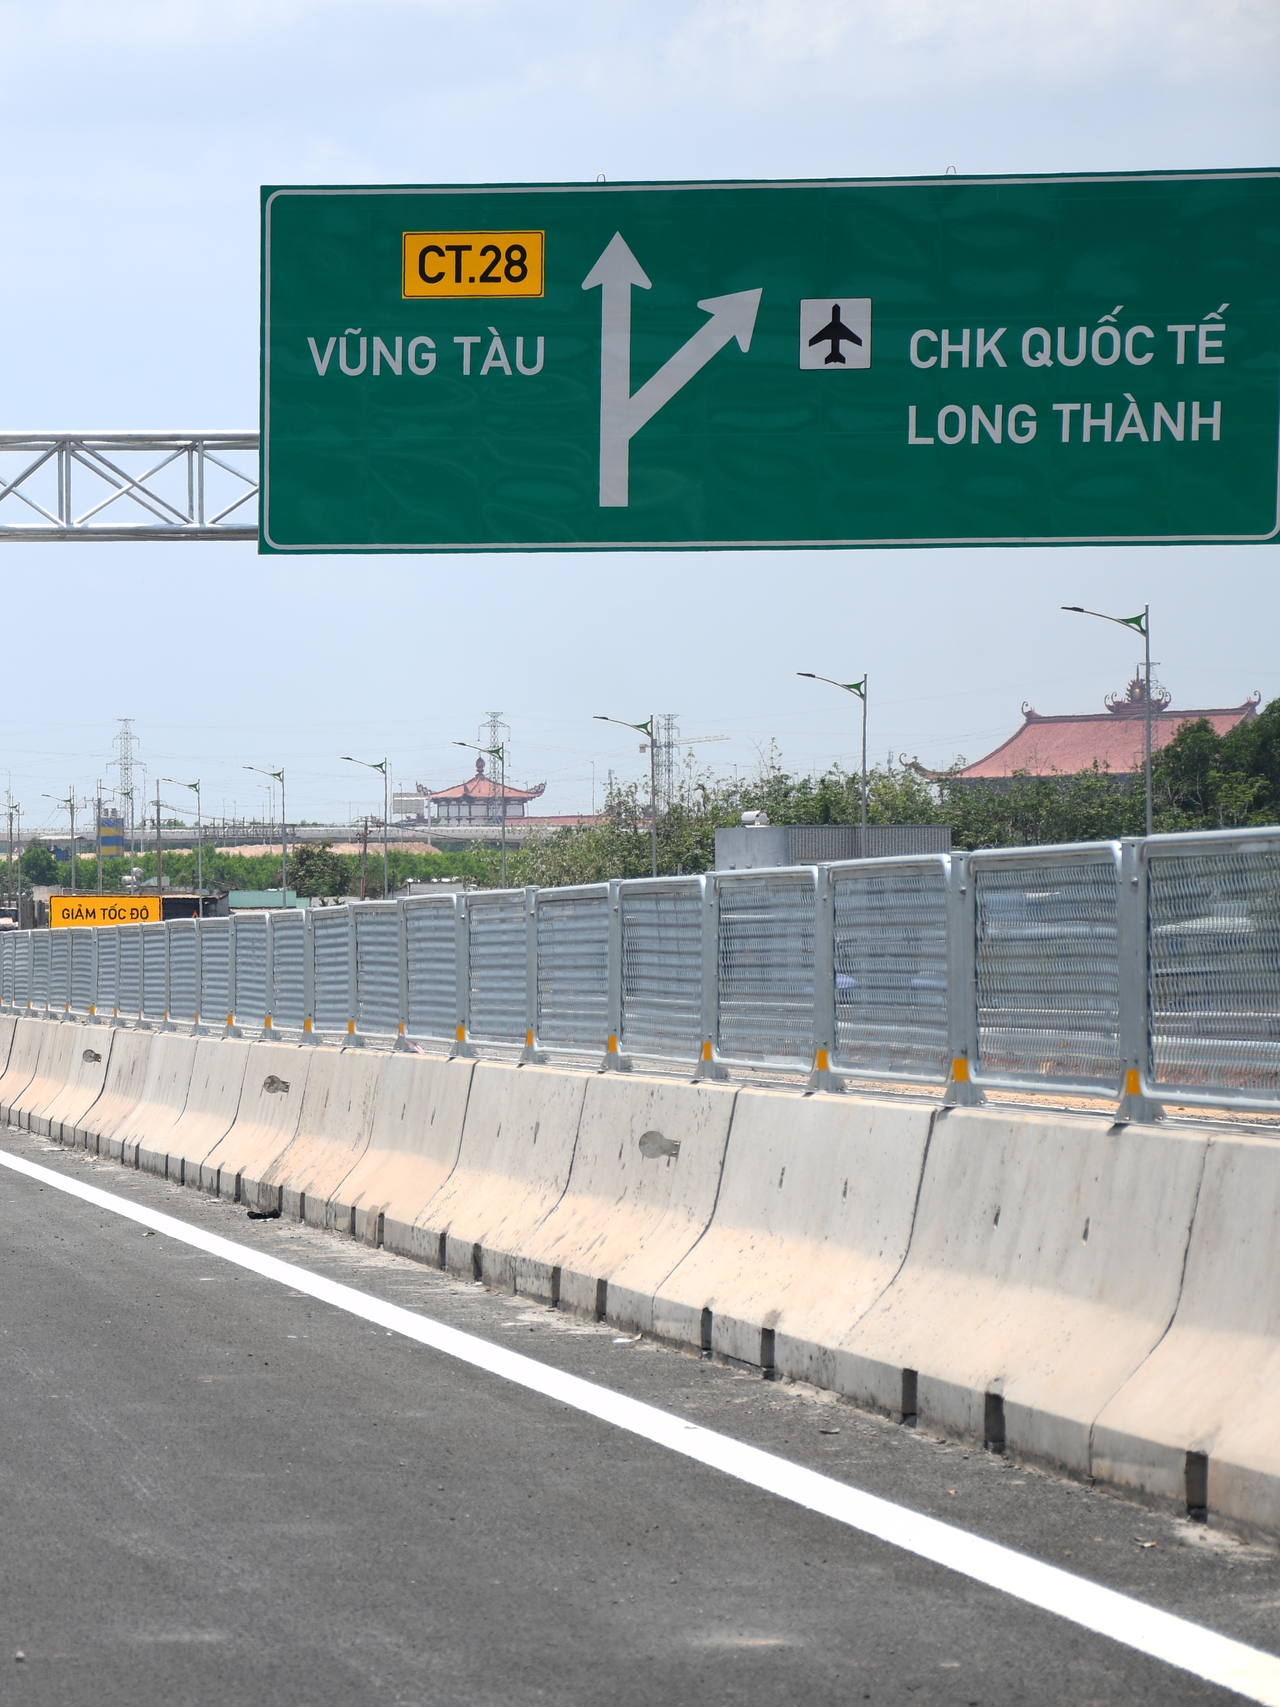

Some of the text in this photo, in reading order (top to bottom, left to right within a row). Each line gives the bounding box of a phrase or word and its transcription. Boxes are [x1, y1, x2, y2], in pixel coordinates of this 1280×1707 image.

[418, 244, 528, 284] CT.28
[307, 326, 545, 376] VŨNG TÀU
[909, 302, 1230, 369] CHK QUỐC TẾ
[907, 392, 1222, 445] LONG THÀNH
[61, 903, 150, 922] GIẢM TỐC ĐỘ
